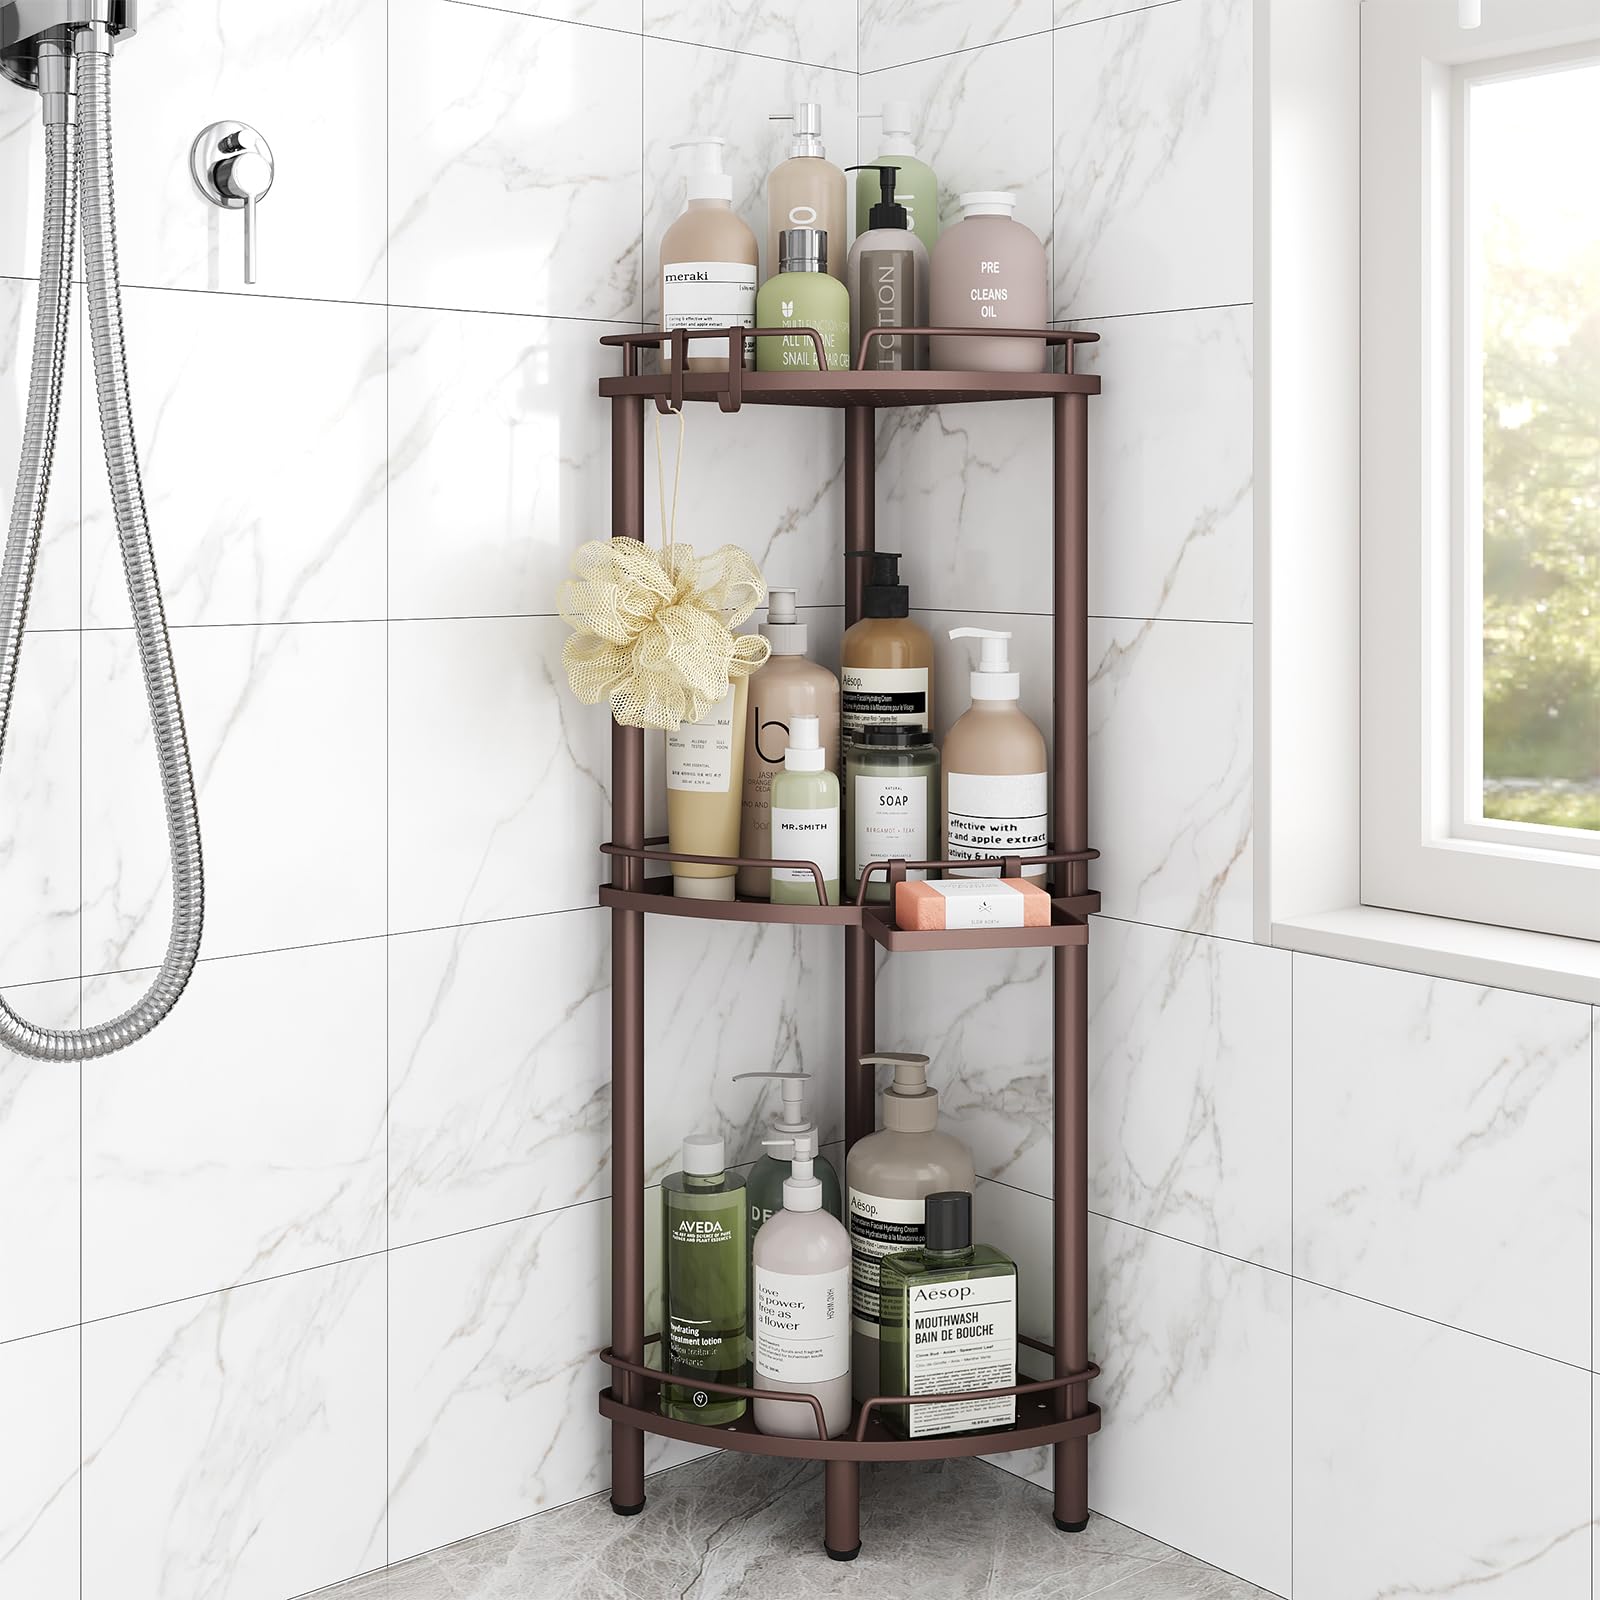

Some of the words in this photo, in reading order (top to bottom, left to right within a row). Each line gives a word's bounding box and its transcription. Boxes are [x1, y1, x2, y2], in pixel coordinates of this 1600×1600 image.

[981, 261, 1000, 274] PRE
[665, 271, 709, 282] meraki
[970, 288, 1008, 301] CLEANS
[981, 305, 997, 318] OIL
[782, 334, 800, 347] ALL
[782, 351, 810, 366] SNAIL
[879, 795, 909, 807] SOAP
[781, 823, 828, 832] MR.SMITH
[950, 819, 986, 832] effective
[990, 823, 1018, 832] with
[954, 832, 969, 841] and
[971, 835, 1002, 845] apple
[1006, 833, 1046, 844] extract
[851, 1196, 878, 1217] Aësop.
[679, 1220, 723, 1233] AVEDA
[759, 1283, 779, 1297] Love
[914, 1286, 976, 1302] Aësop.
[758, 1301, 775, 1316] free
[777, 1310, 792, 1319] as
[765, 1297, 806, 1310] power,
[764, 1315, 801, 1331] flower
[915, 1311, 979, 1330] MOUTHWASH
[670, 1321, 700, 1337] hydrating
[915, 1331, 938, 1345] BAIN
[941, 1329, 953, 1342] DE
[956, 1323, 994, 1340] BOUCHE
[670, 1332, 700, 1346] treatment
[701, 1336, 722, 1346] lotion
